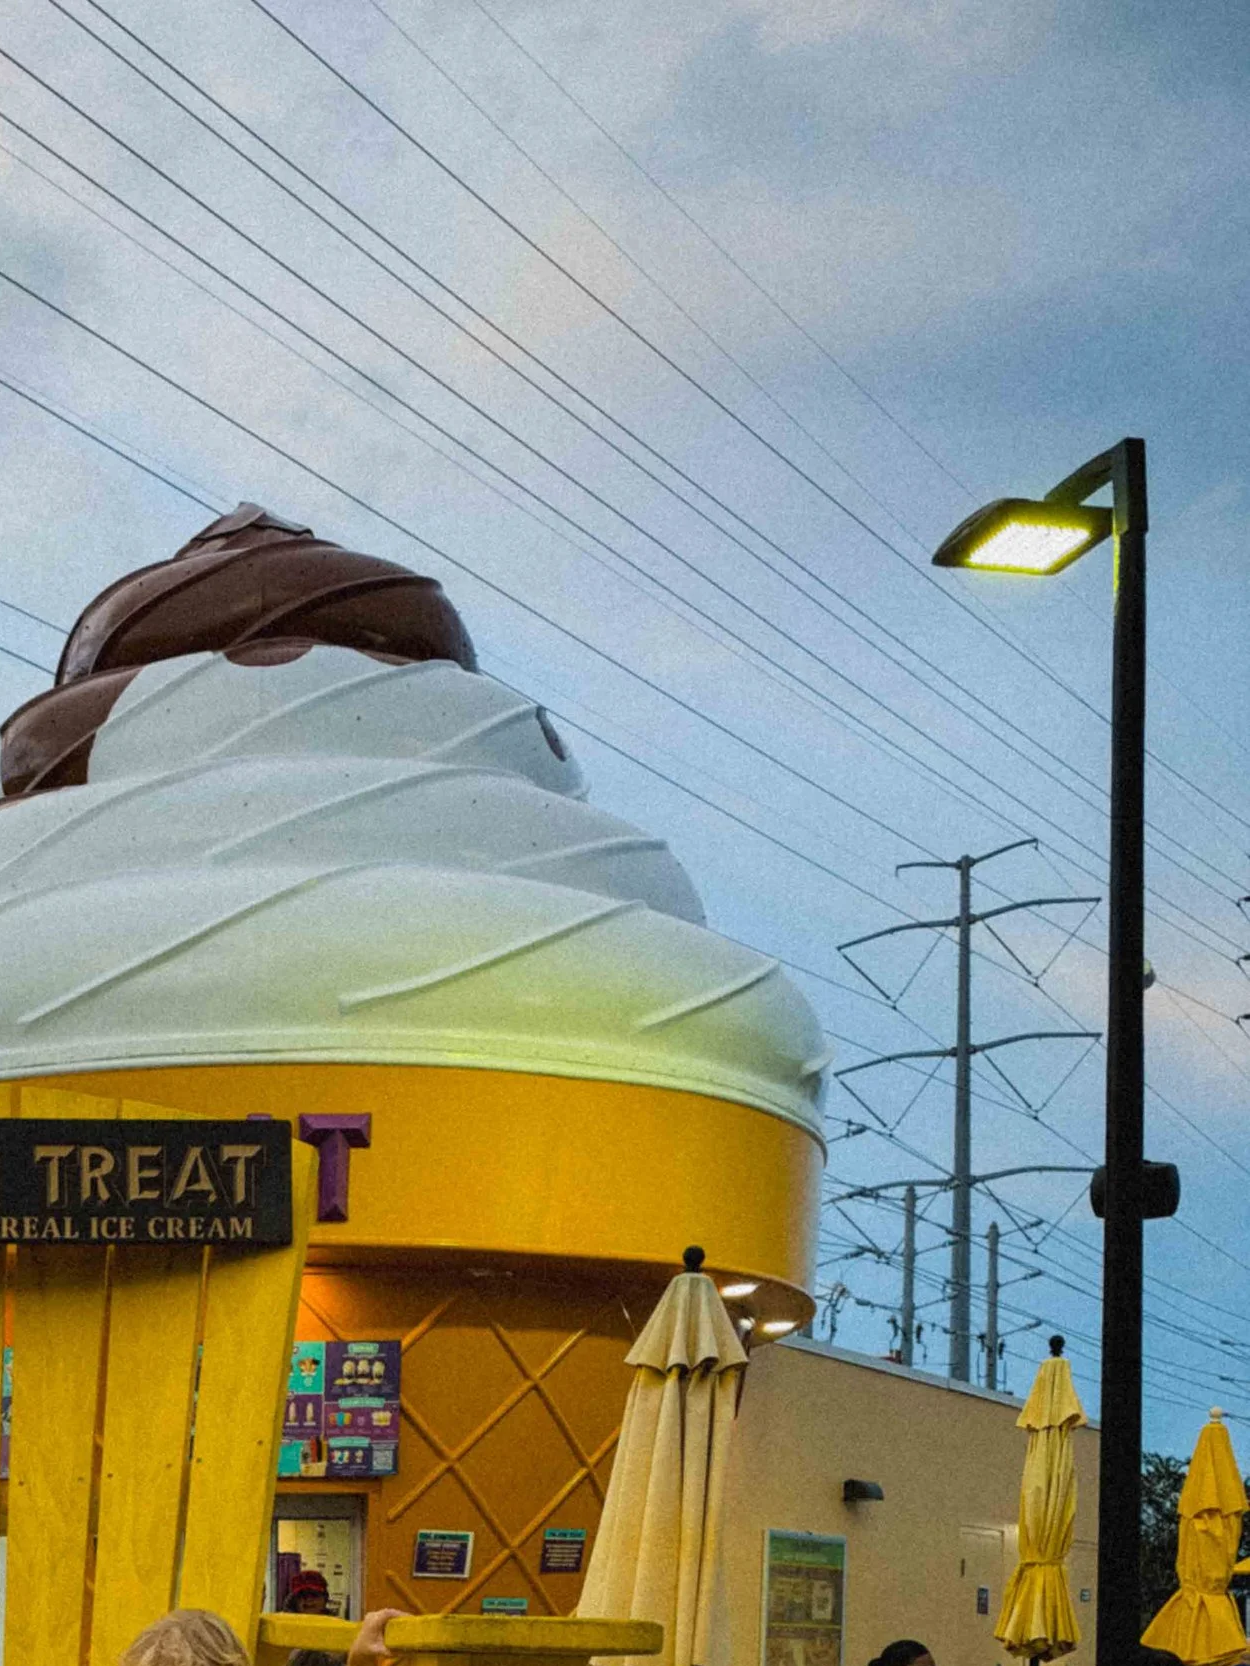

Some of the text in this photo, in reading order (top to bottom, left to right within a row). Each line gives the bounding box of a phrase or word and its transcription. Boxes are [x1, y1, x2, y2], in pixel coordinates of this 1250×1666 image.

[33, 1144, 264, 1206] TREAT
[0, 1216, 80, 1240] REAL
[89, 1216, 137, 1240] ICE
[147, 1216, 254, 1241] CREAM
